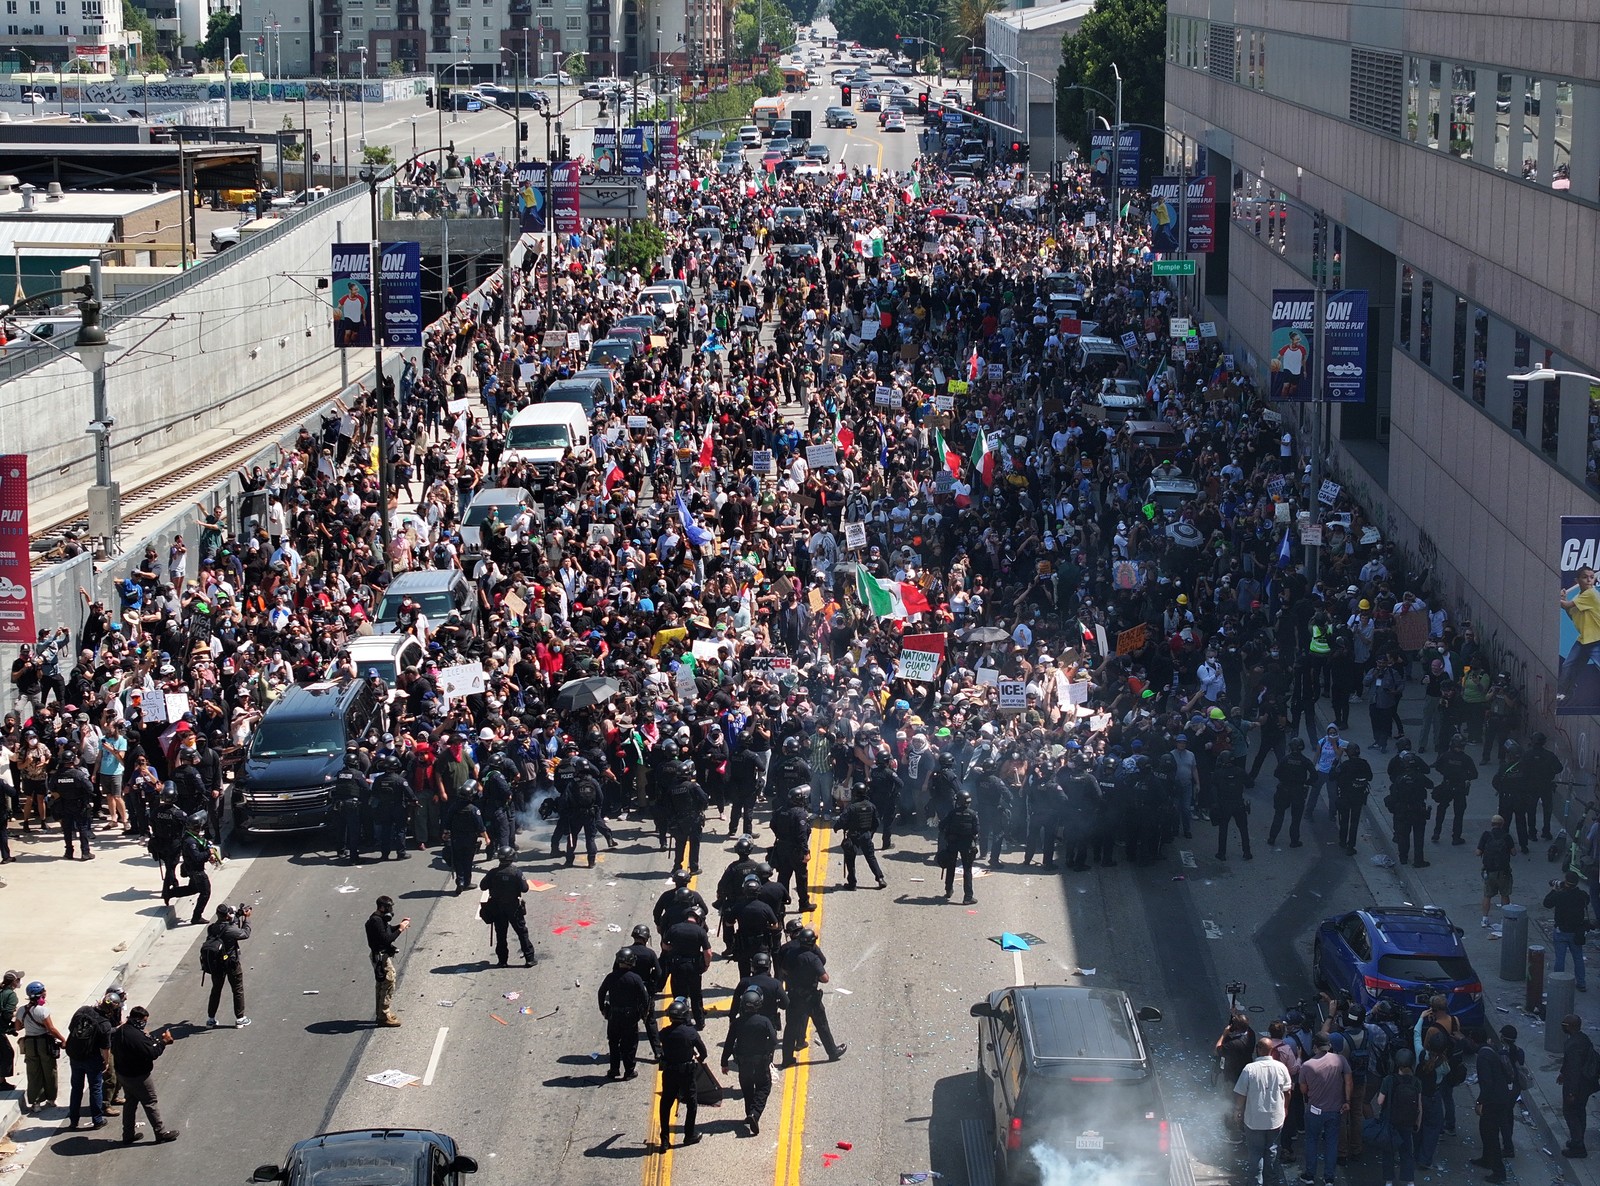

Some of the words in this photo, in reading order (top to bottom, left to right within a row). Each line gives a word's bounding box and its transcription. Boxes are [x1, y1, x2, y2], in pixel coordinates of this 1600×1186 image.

[595, 133, 616, 144] GAME
[622, 133, 636, 144] ON!
[1092, 136, 1114, 146] GAME
[1120, 136, 1132, 146] ON!
[519, 170, 546, 182] GAME
[553, 170, 570, 181] ON!
[1151, 185, 1179, 197] GAME
[1187, 185, 1205, 196] ON!
[332, 254, 371, 271] GAME
[382, 254, 406, 271] ON!
[1272, 302, 1314, 320] GAME
[1326, 302, 1353, 320] ON!
[1, 509, 23, 522] PLAY
[901, 651, 936, 662] NATIONAL
[752, 660, 774, 671] FUCK
[772, 659, 791, 669] ICE
[905, 661, 931, 671] GUARD
[905, 670, 922, 679] LOL
[142, 691, 160, 700] ICE
[1001, 685, 1024, 695] ICE:
